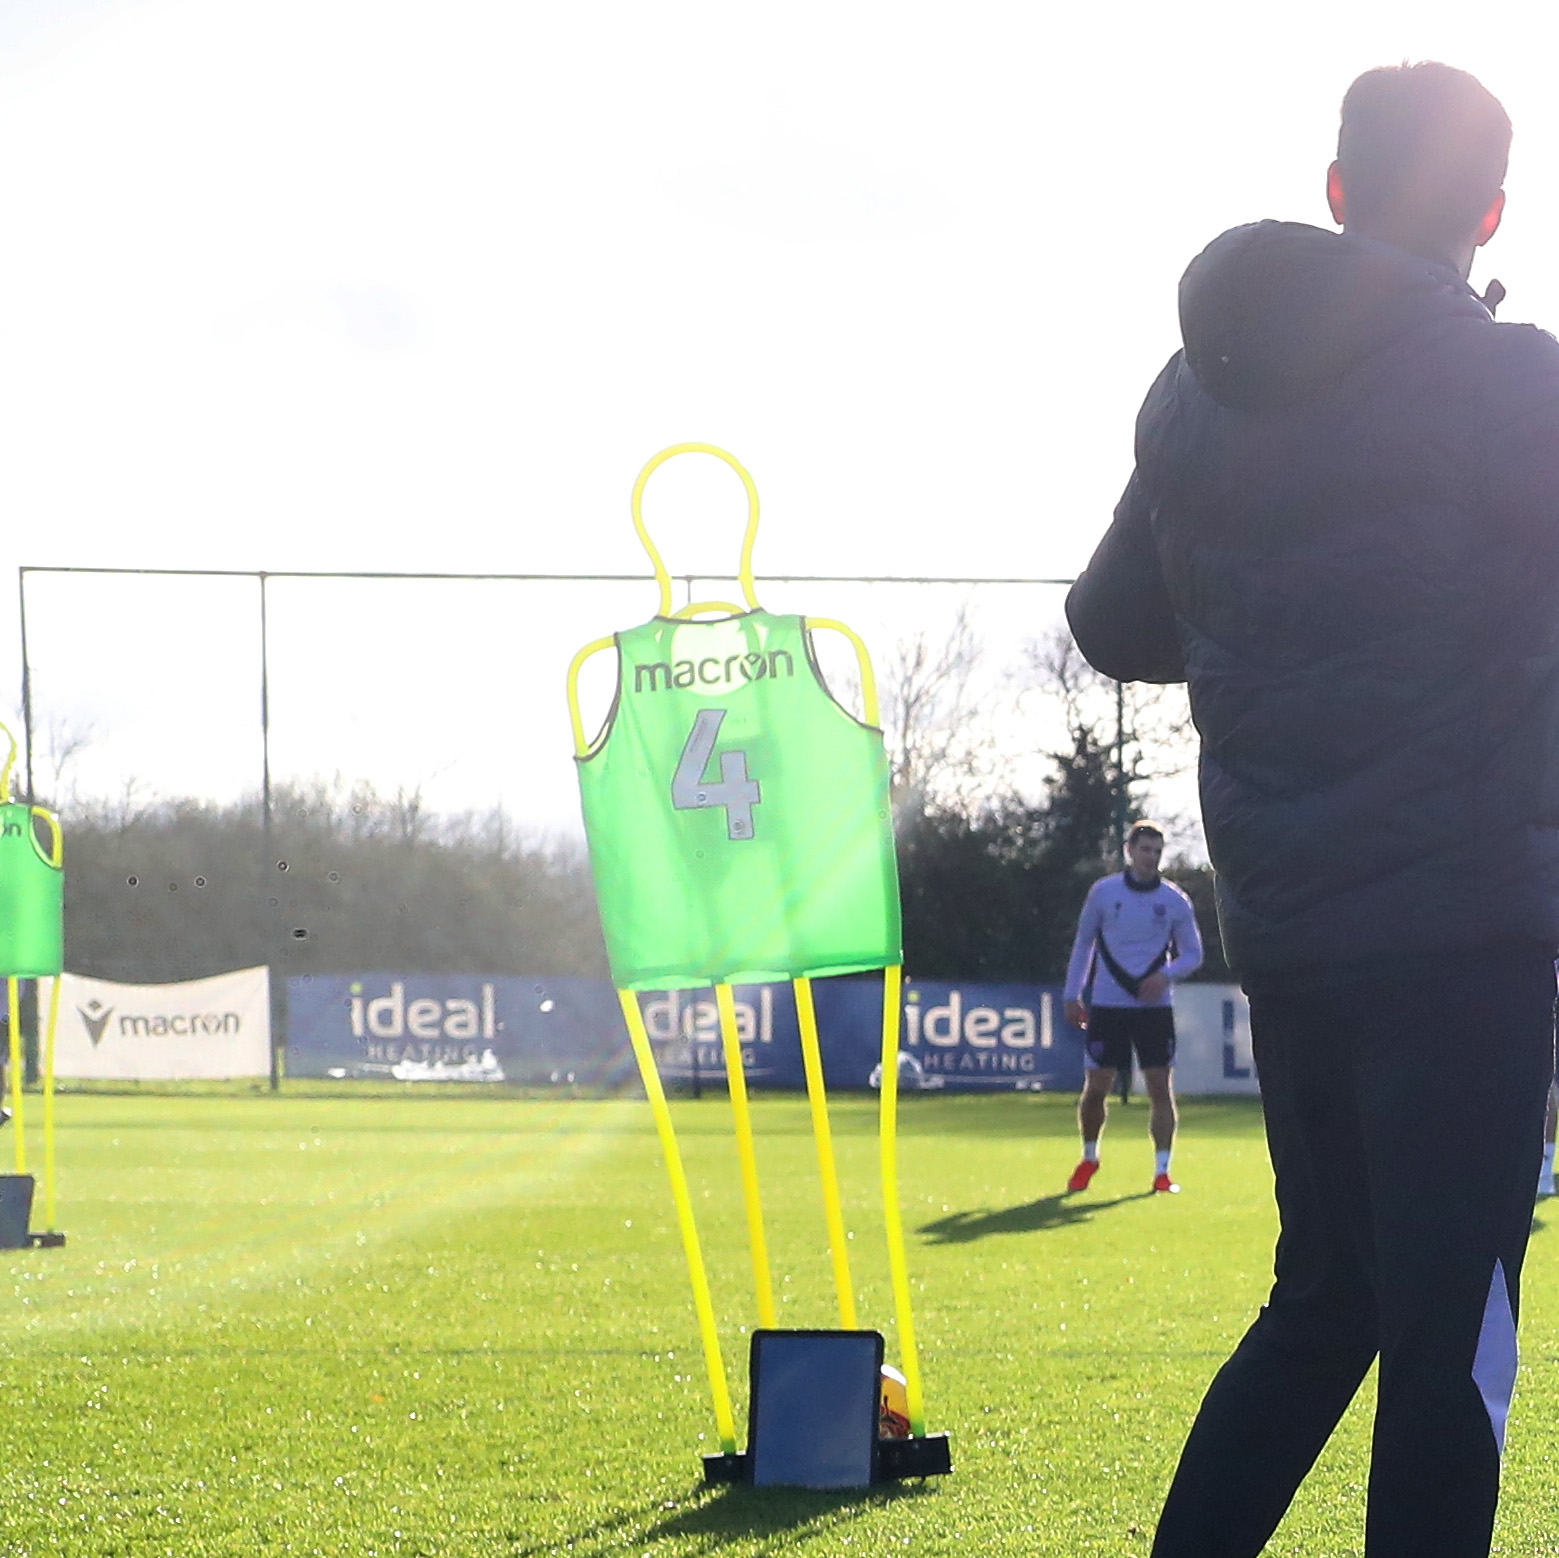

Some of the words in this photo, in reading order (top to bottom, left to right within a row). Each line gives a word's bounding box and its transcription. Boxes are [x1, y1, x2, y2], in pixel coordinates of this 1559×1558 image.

[635, 650, 793, 692] macron
[671, 708, 761, 840] 4
[119, 1013, 241, 1037] macron
[350, 982, 496, 1039] ideal
[643, 986, 773, 1043] deal
[905, 990, 1053, 1048] ideal
[923, 1053, 1036, 1072] HEATING
